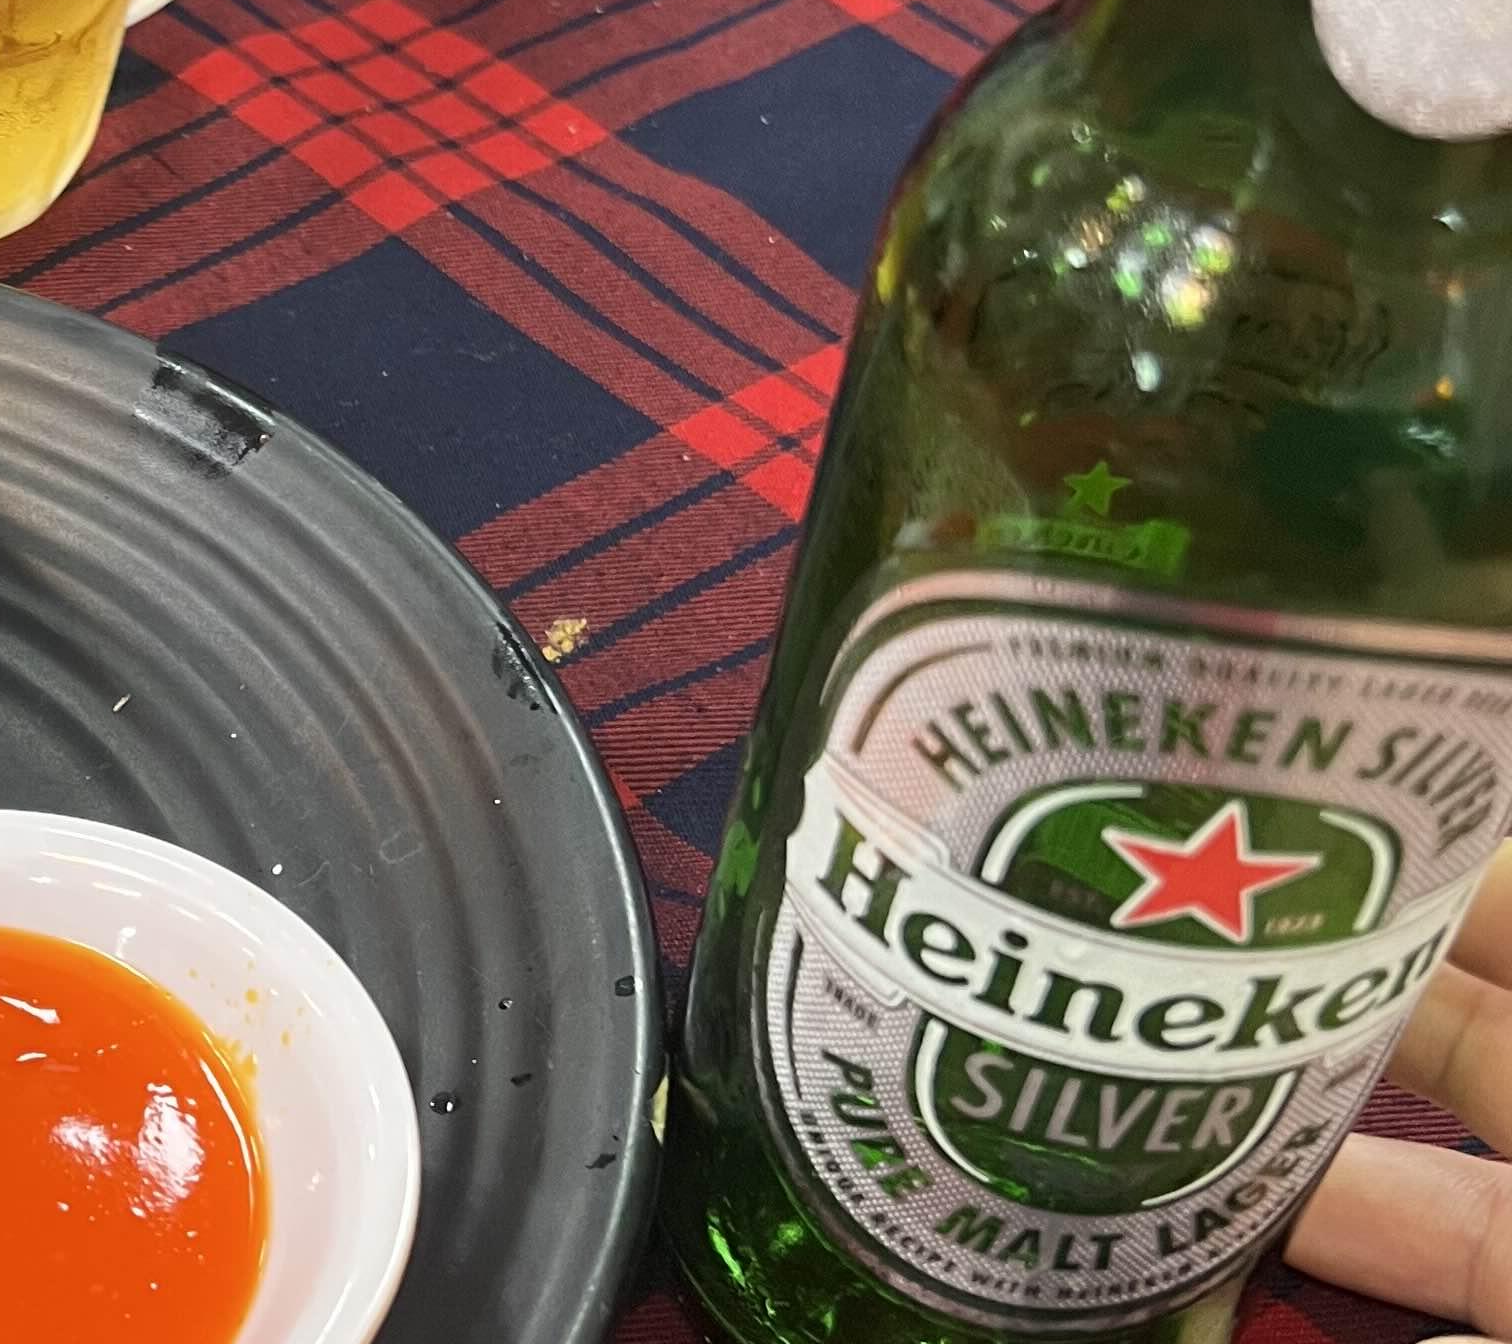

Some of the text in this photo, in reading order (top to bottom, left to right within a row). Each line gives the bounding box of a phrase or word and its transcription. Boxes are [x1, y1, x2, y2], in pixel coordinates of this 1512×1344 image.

[912, 685, 1354, 793] HEINEKEN
[814, 808, 1449, 1054] Heineken
[821, 1049, 934, 1202] PURE
[934, 1204, 1123, 1271] MALT
[1155, 1117, 1335, 1256] LAGER
[951, 1050, 1254, 1154] SILVER
